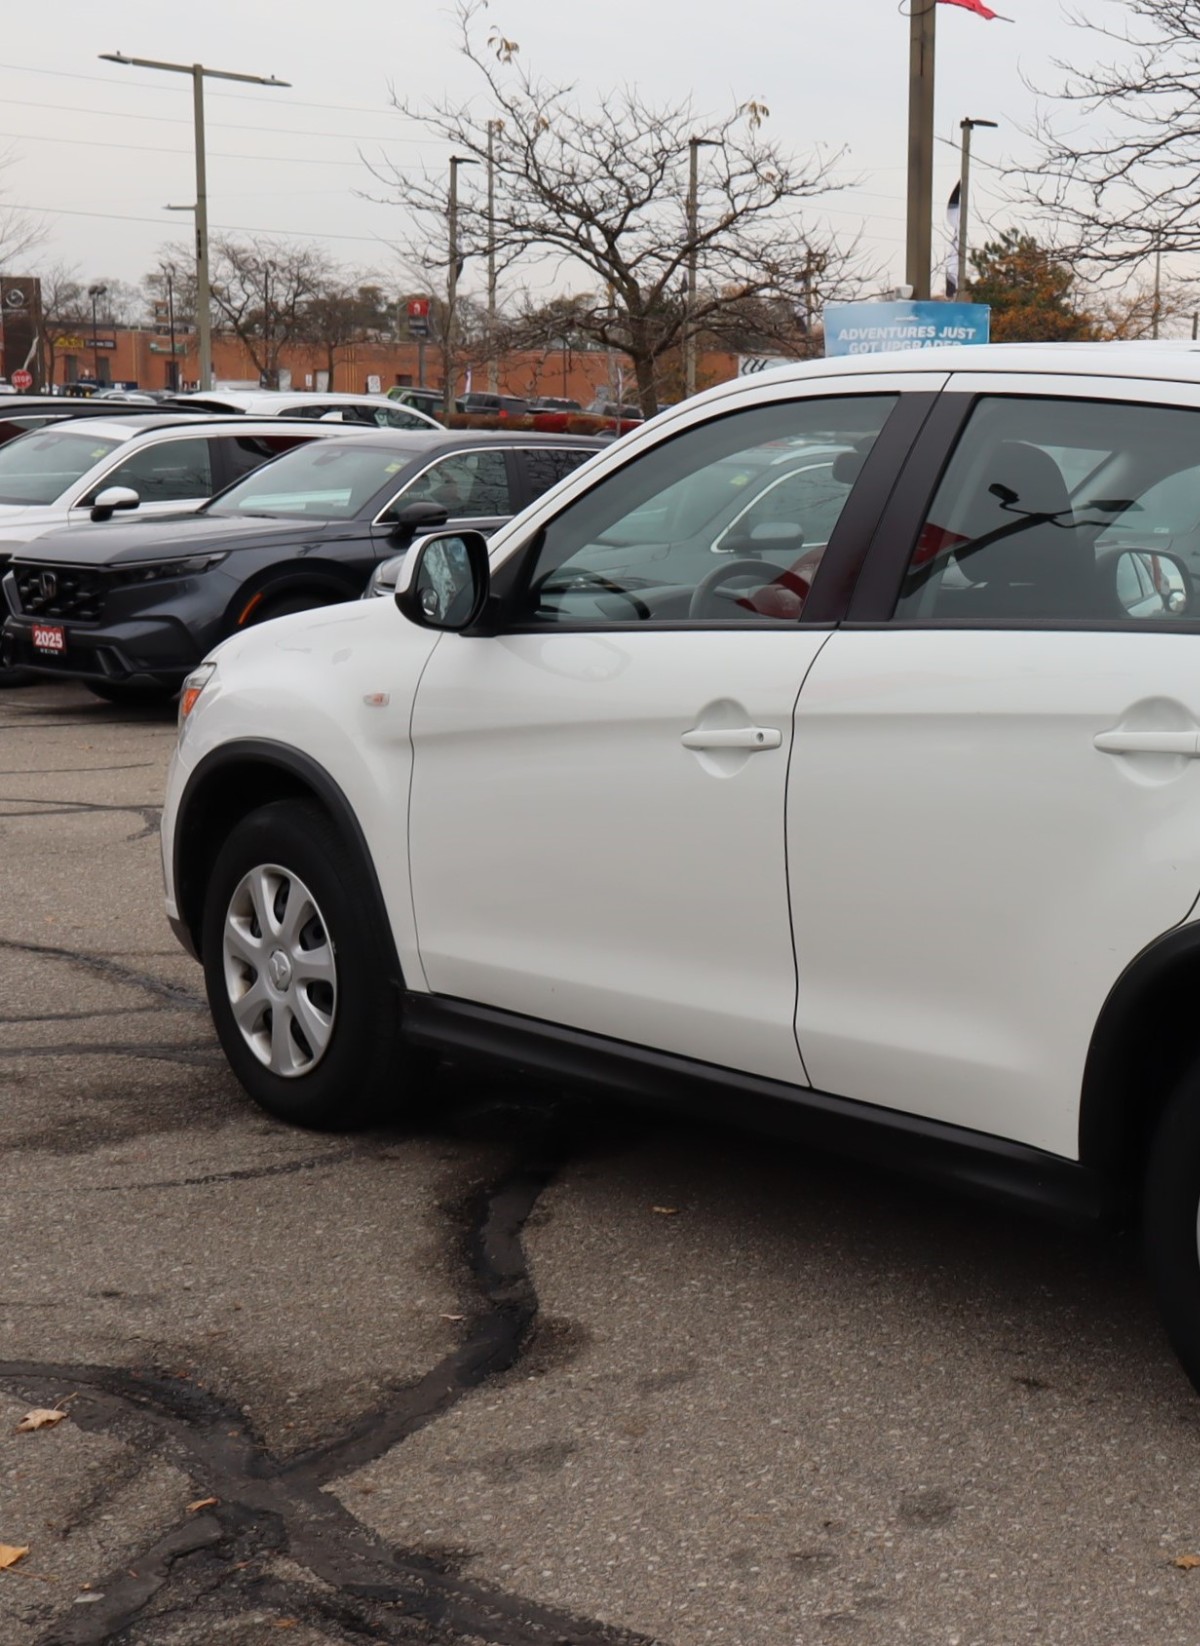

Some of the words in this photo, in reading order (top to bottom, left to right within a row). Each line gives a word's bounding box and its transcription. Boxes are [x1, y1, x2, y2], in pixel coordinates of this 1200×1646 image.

[838, 326, 936, 341] ADVENTURES
[938, 326, 976, 340] JUST
[848, 341, 879, 354] GOT
[12, 375, 32, 384] STOP
[34, 630, 63, 649] 2025
